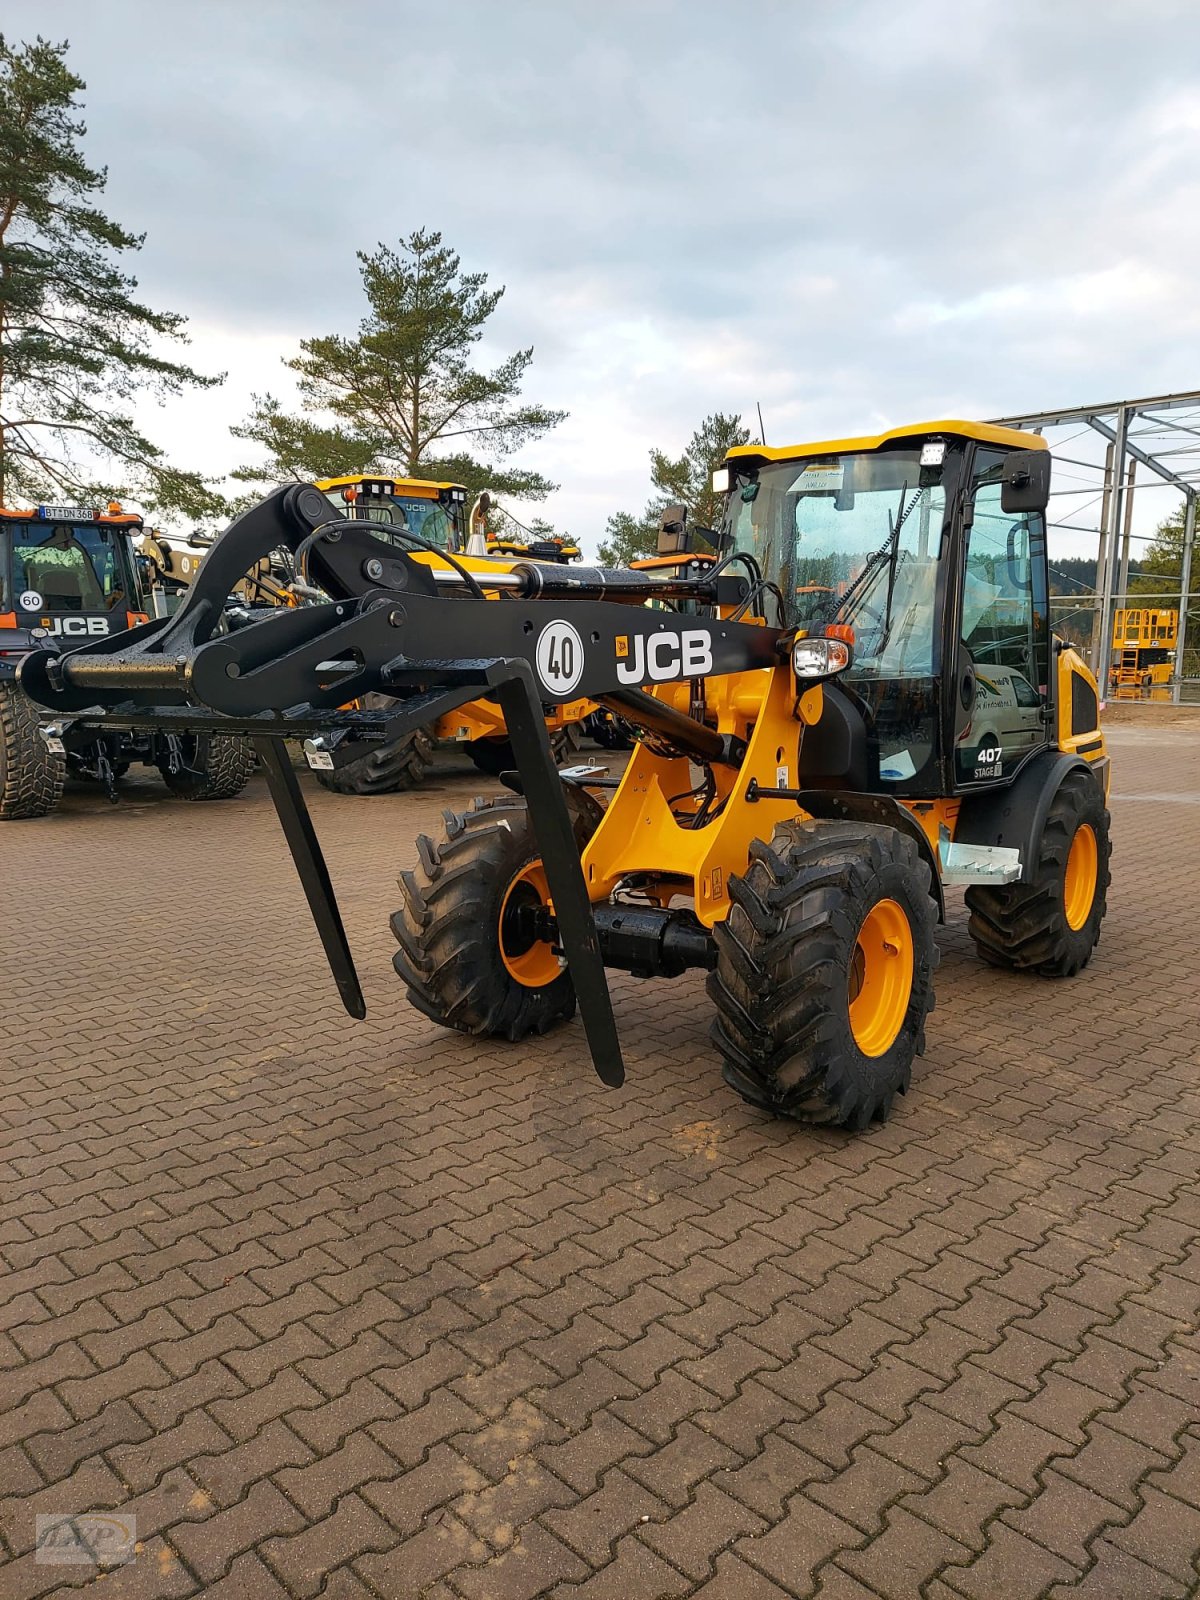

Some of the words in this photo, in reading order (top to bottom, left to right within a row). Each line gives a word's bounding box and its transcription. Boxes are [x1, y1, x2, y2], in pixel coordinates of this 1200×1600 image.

[45, 508, 57, 517] BT
[64, 509, 75, 518] DN
[406, 503, 426, 512] JCB
[23, 596, 40, 606] 60
[44, 617, 109, 637] JCB
[548, 636, 573, 679] 40
[616, 629, 713, 685] JCB
[977, 747, 1003, 763] 407
[974, 766, 994, 778] STAGE
